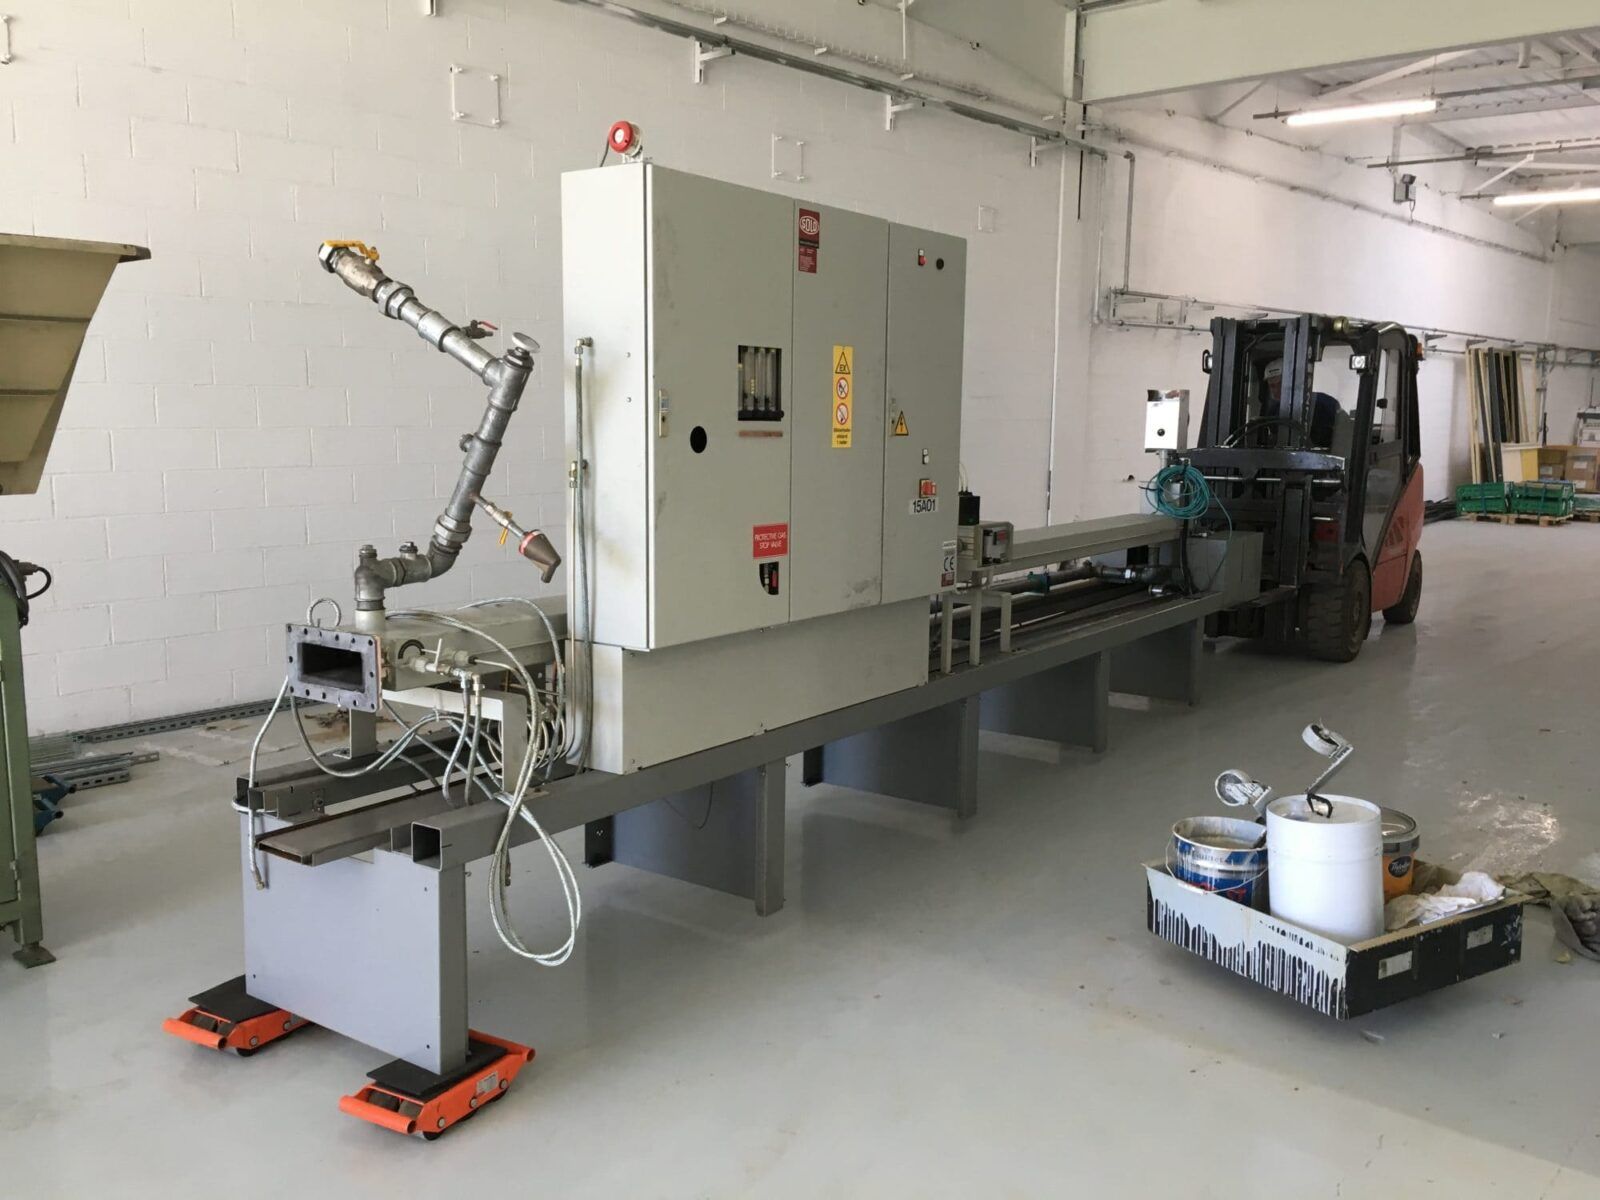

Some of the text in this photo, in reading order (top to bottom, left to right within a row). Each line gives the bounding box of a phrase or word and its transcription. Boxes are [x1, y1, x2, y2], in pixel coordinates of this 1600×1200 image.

[801, 217, 818, 233] SOLO
[913, 498, 936, 513] 15A01
[755, 533, 777, 541] PROTECTIVE
[759, 540, 781, 549] STOP VALVE
